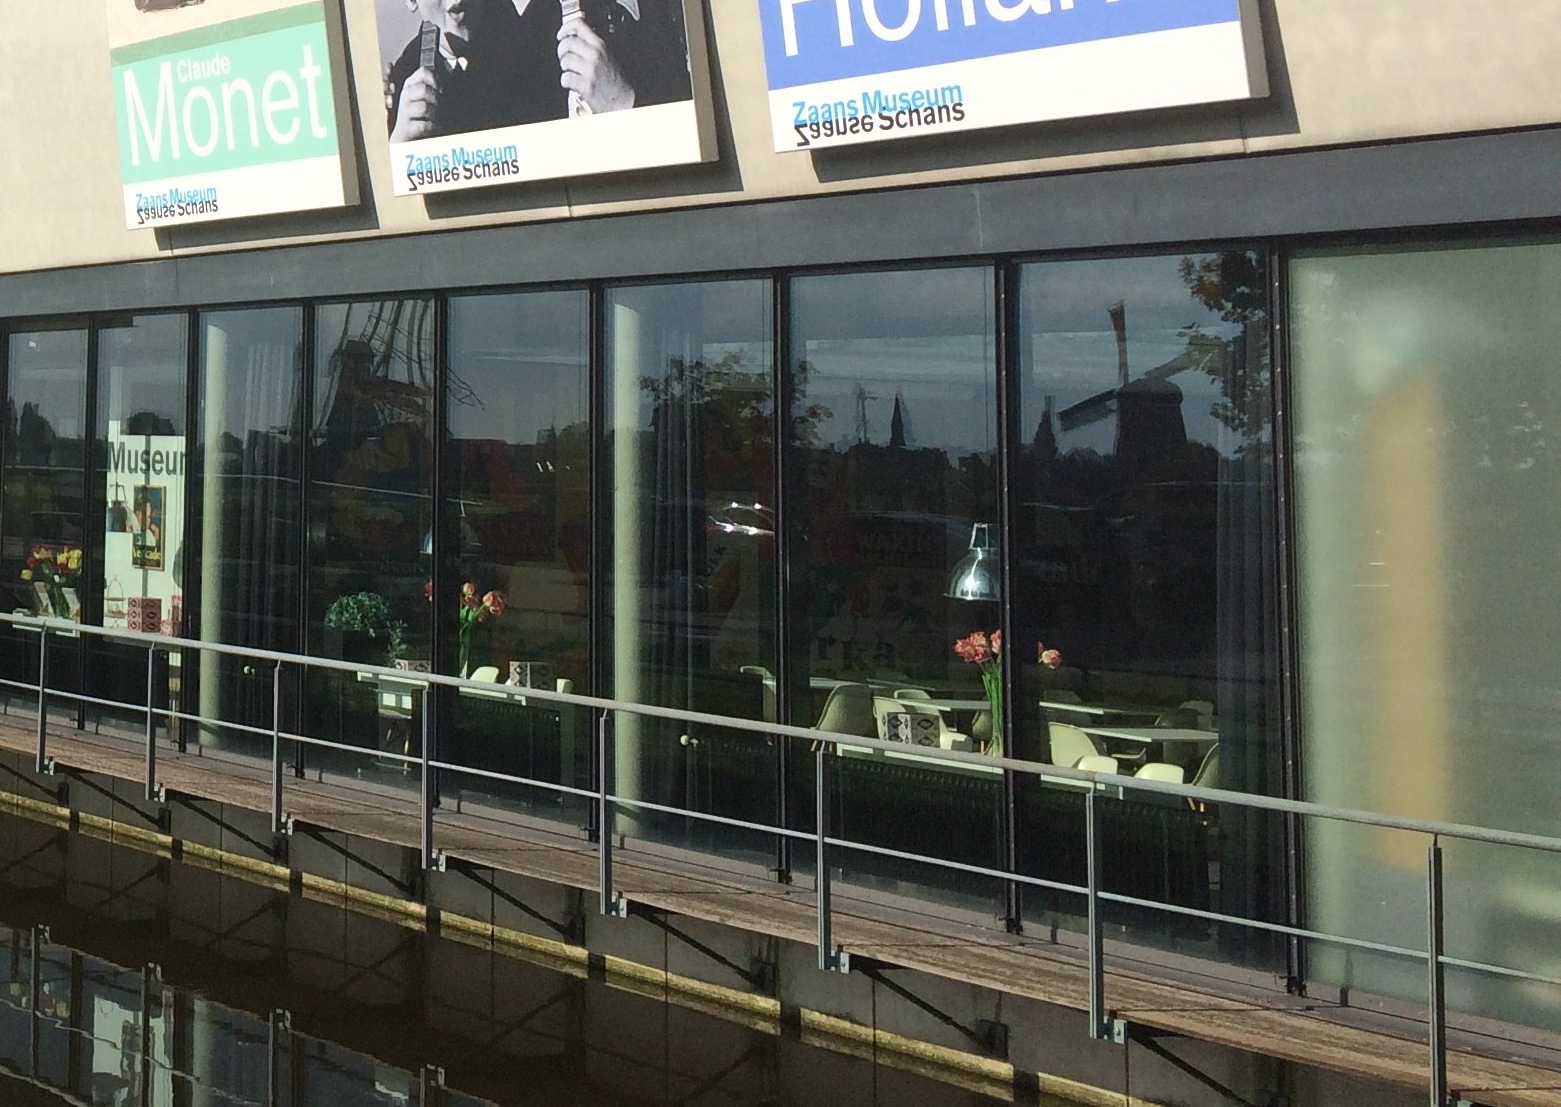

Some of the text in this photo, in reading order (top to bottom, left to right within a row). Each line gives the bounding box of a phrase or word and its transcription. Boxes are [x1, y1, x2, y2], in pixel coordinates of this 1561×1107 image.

[177, 52, 231, 82] Claude
[123, 44, 327, 166] Monet
[792, 84, 963, 125] Zaans Museum
[405, 145, 518, 175] Zaans Museum
[136, 187, 217, 209] Zaans Museum
